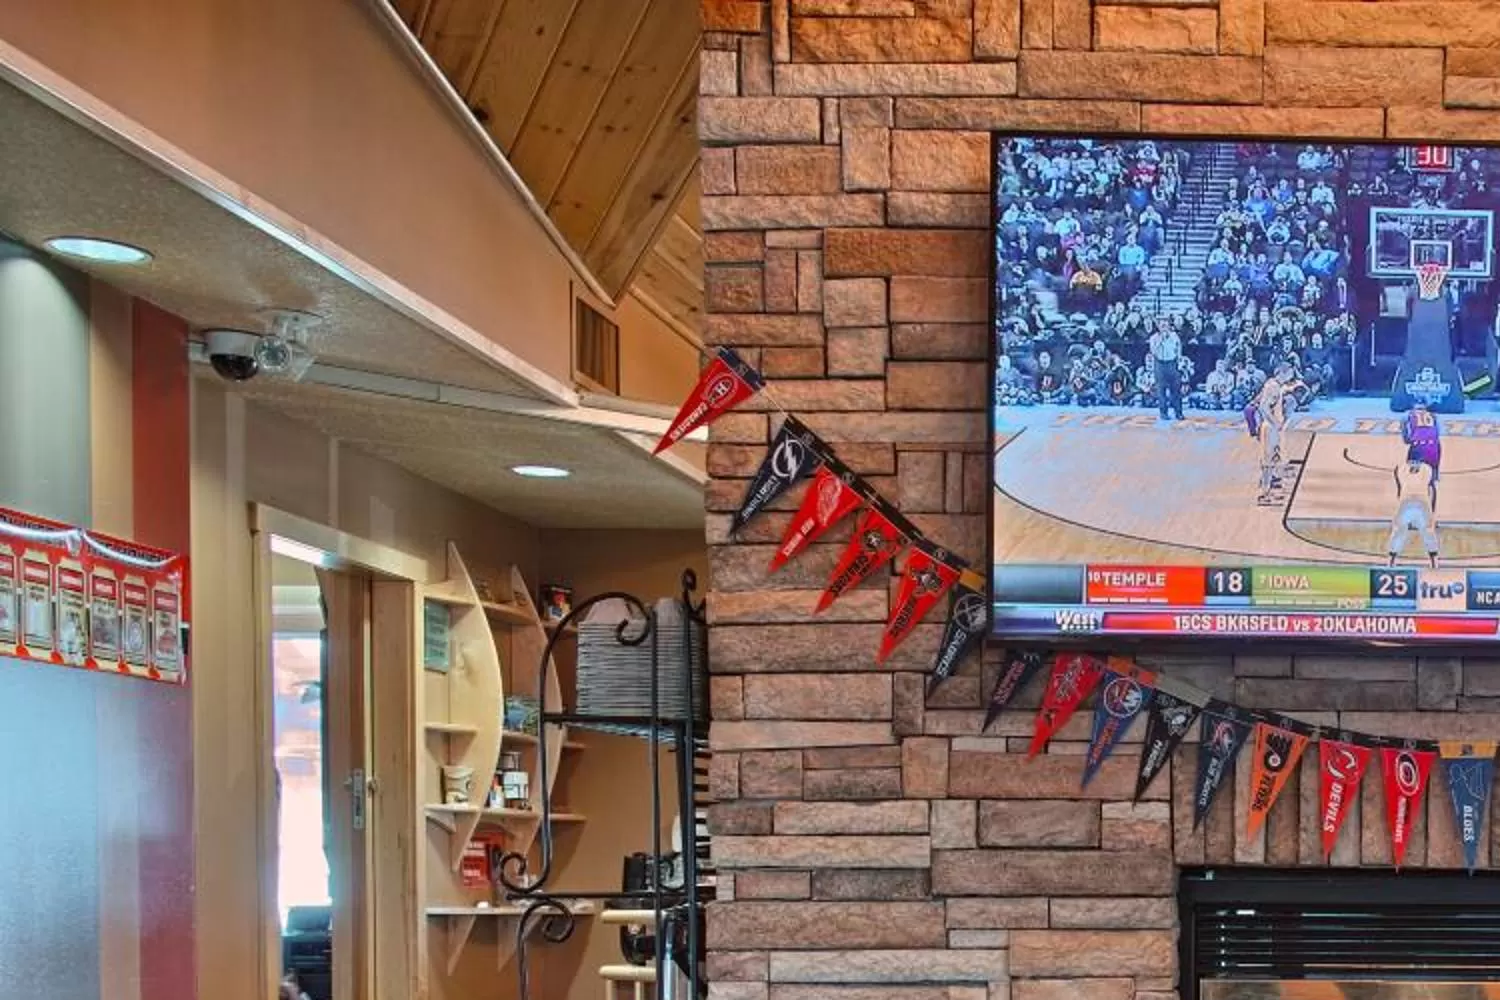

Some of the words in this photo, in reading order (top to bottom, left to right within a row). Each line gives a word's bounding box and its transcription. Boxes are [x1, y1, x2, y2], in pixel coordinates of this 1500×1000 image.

[1102, 571, 1167, 587] TEMPLE
[1213, 571, 1245, 594] 18
[1268, 575, 1310, 590] IOWA
[1377, 574, 1408, 596] 25
[1215, 615, 1288, 632] BKRSFLD
[1292, 619, 1310, 632] vs
[1322, 779, 1344, 832] DEVILS
[1462, 804, 1474, 842] BLUES
